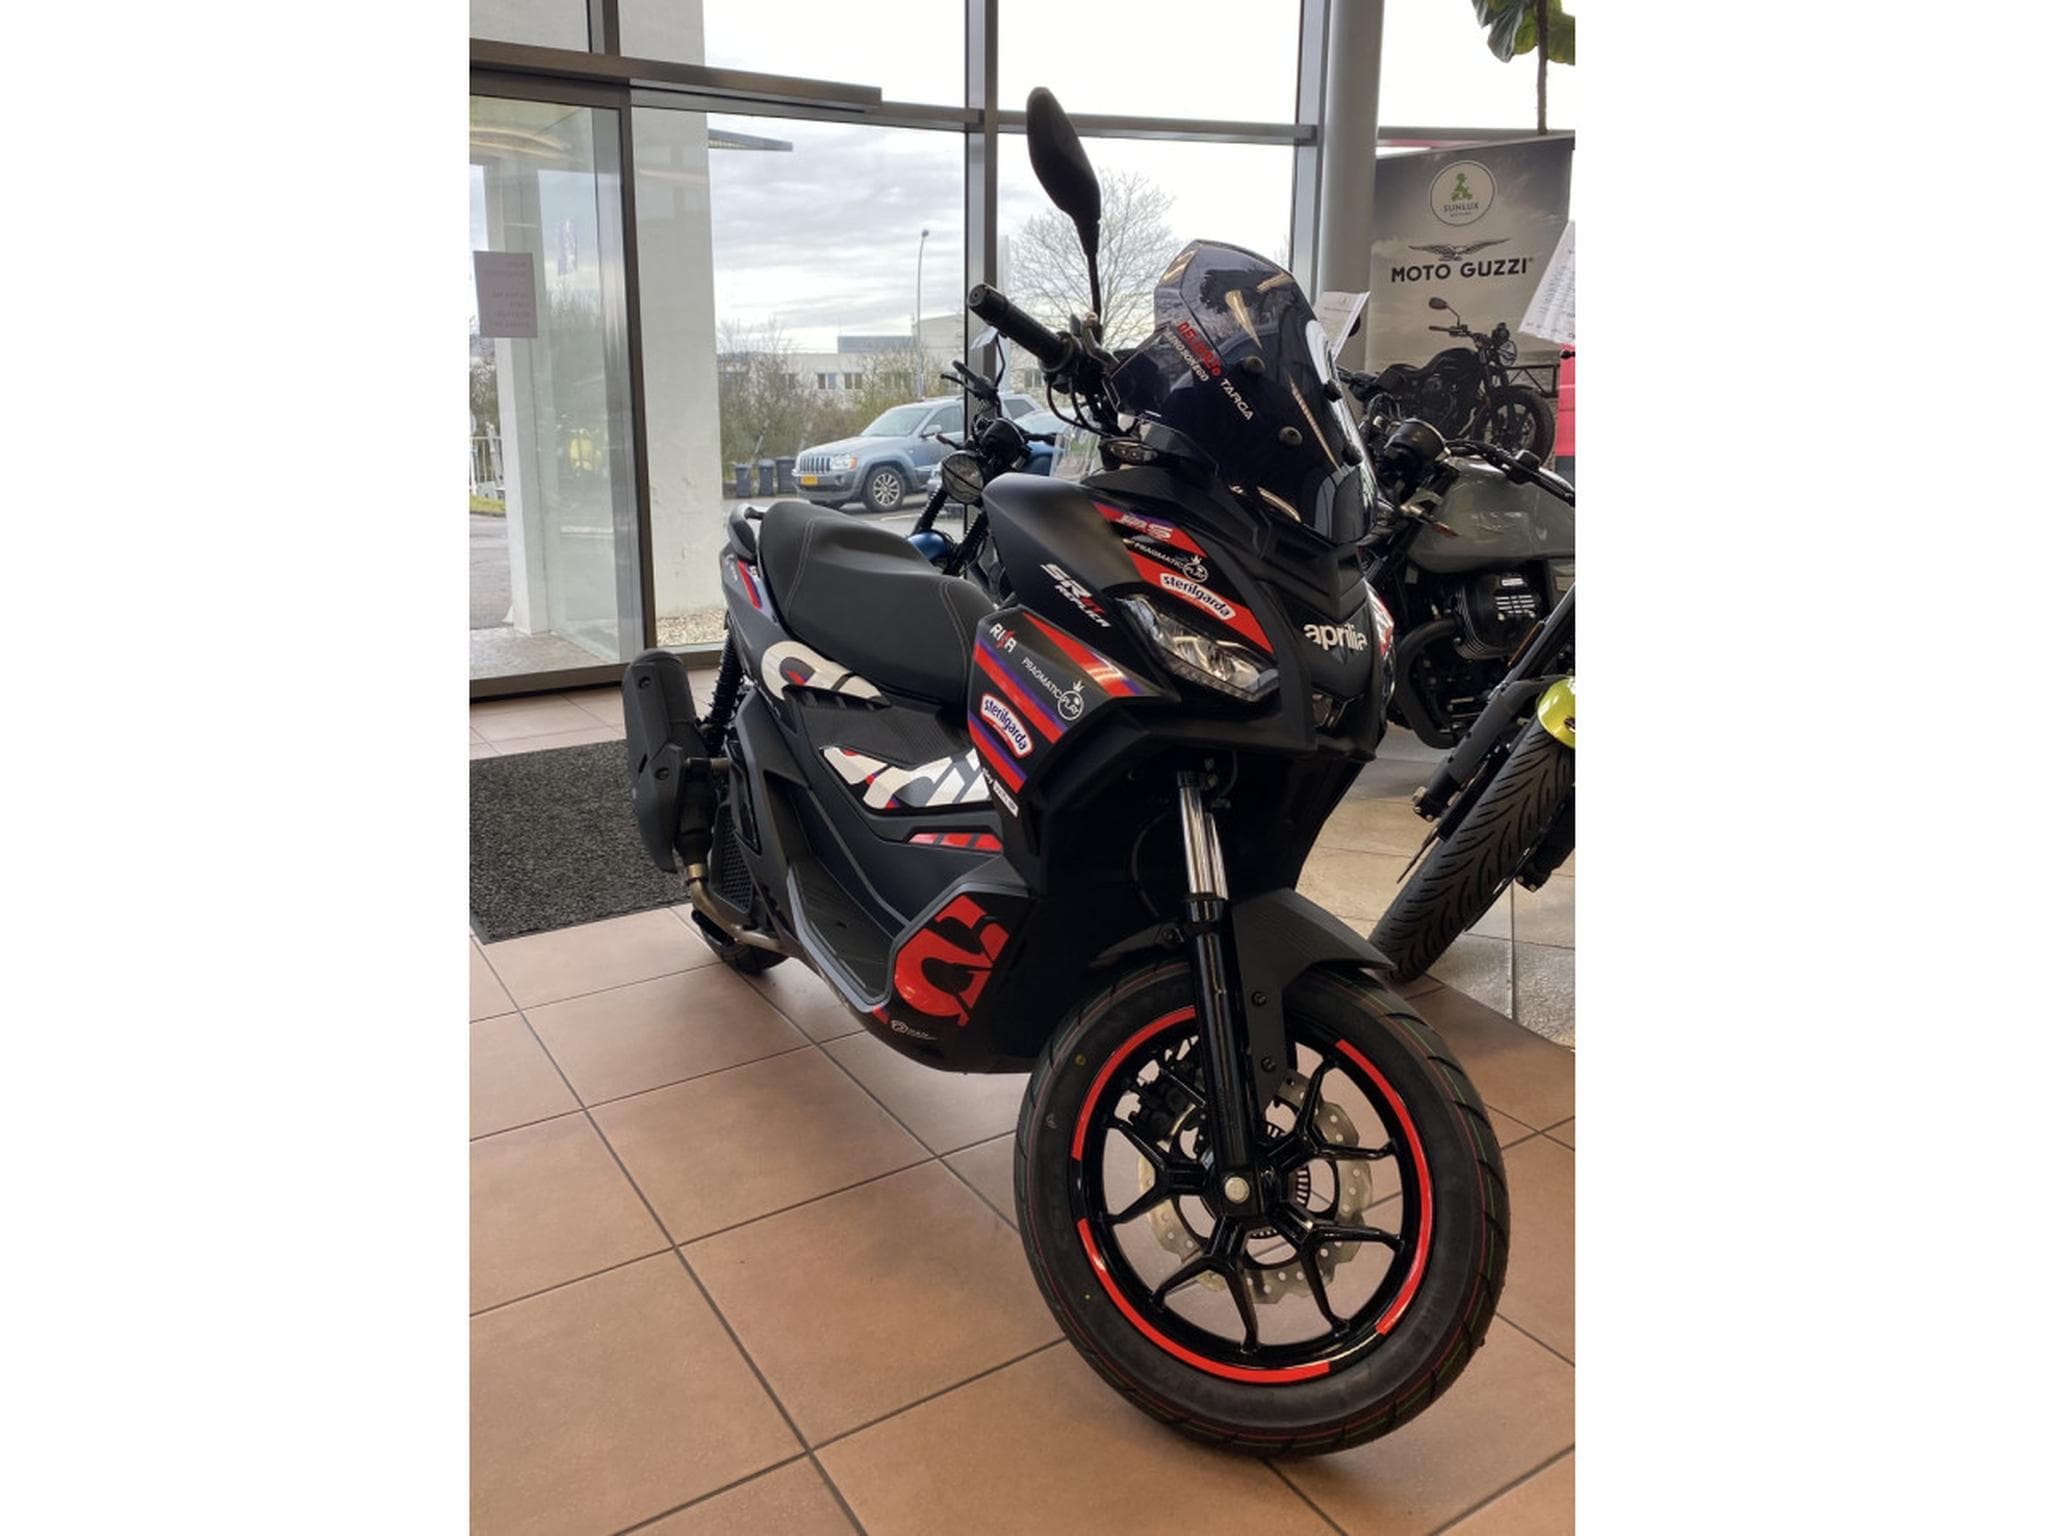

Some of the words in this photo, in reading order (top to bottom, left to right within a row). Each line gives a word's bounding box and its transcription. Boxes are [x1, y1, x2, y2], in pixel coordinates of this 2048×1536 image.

[1443, 202, 1480, 213] SUNLUX
[1391, 263, 1451, 283] MOTO
[1460, 258, 1527, 278] GUZZI
[1220, 378, 1253, 420] TARGA
[1162, 575, 1231, 617] sterilgarda
[1303, 622, 1368, 651] aprilia
[1021, 656, 1063, 699] PRAGMATIC
[983, 699, 1028, 751] sterilgarda
